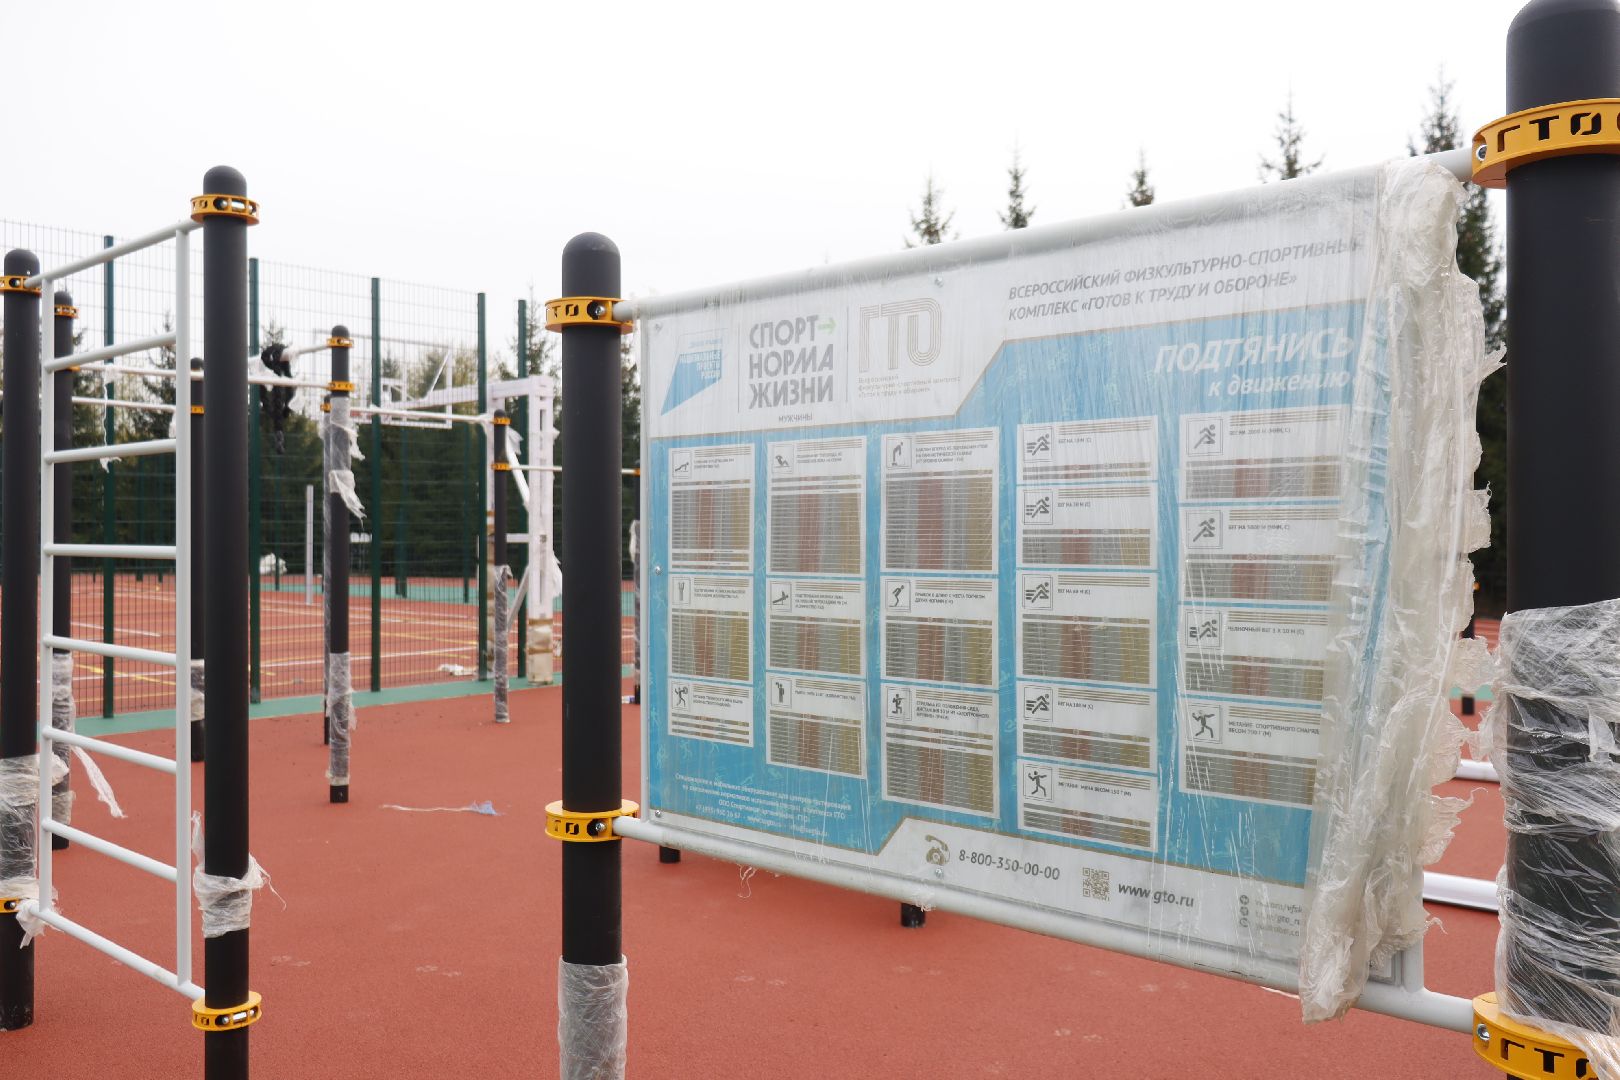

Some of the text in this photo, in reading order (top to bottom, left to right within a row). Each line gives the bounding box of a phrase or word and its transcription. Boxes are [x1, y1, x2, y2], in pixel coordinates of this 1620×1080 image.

[1008, 268, 1121, 300] ВСЕРОССИЙСКИЙ
[1008, 271, 1297, 321] КОМПЛЕКС «ГОТОВ К ТРУДУ И ОБОРОНЕ»
[749, 315, 819, 349] СПОРТ
[858, 297, 943, 373] ГТО
[749, 344, 834, 379] НОРМА
[1154, 327, 1355, 374] ПОДТЯНИСЬ
[749, 375, 834, 409] ЖИЗНИ
[1208, 370, 1350, 397] к движению
[778, 412, 813, 423] МУЖЧИНЫ
[958, 850, 1061, 881] 8-800-350-00-00
[1117, 881, 1195, 908] www.gto.ru
